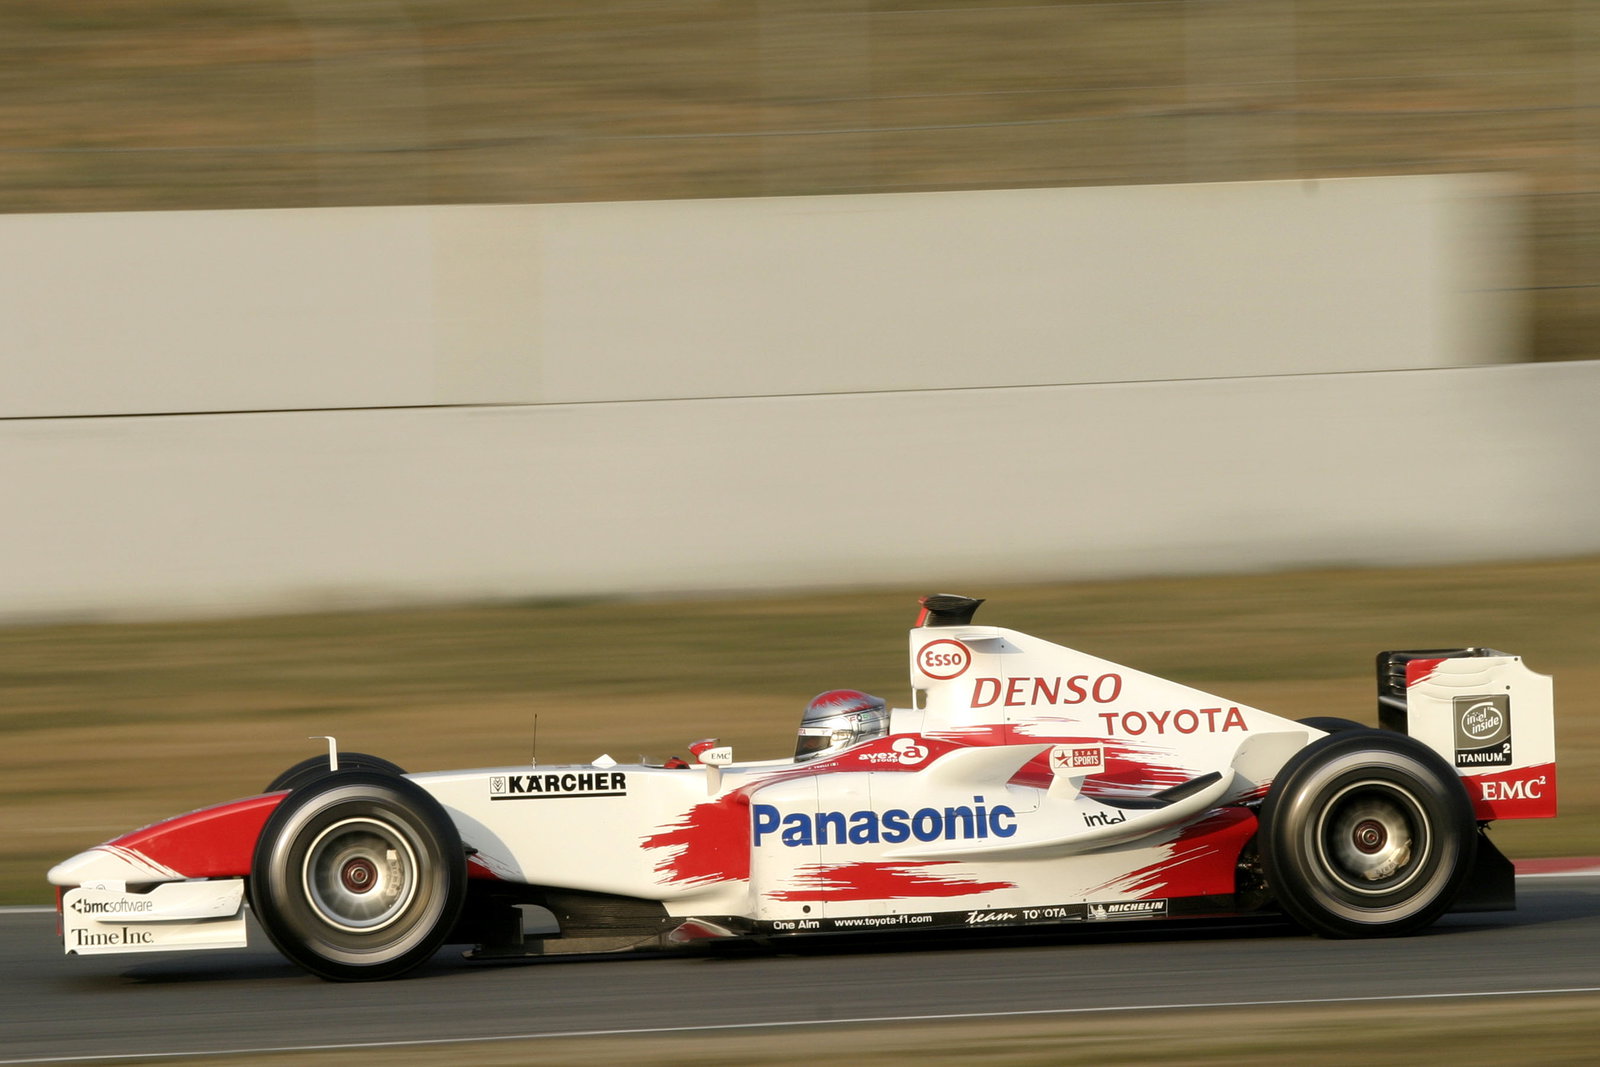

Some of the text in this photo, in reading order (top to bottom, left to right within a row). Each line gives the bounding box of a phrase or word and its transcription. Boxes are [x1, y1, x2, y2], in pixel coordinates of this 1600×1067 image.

[925, 651, 962, 667] Esso
[970, 673, 1122, 708] DENSO
[1098, 707, 1249, 736] TOYOTA
[1472, 716, 1500, 734] inside
[858, 752, 898, 761] avex
[1073, 756, 1100, 766] SPORTS
[508, 772, 627, 794] KÄRCHER
[753, 795, 1018, 848] Panasonic
[1108, 901, 1164, 913] MICHELIN
[773, 919, 820, 930] One Aim
[834, 914, 933, 927] www.toyota-f1.com
[965, 910, 1018, 925] team
[71, 928, 119, 946] Time
